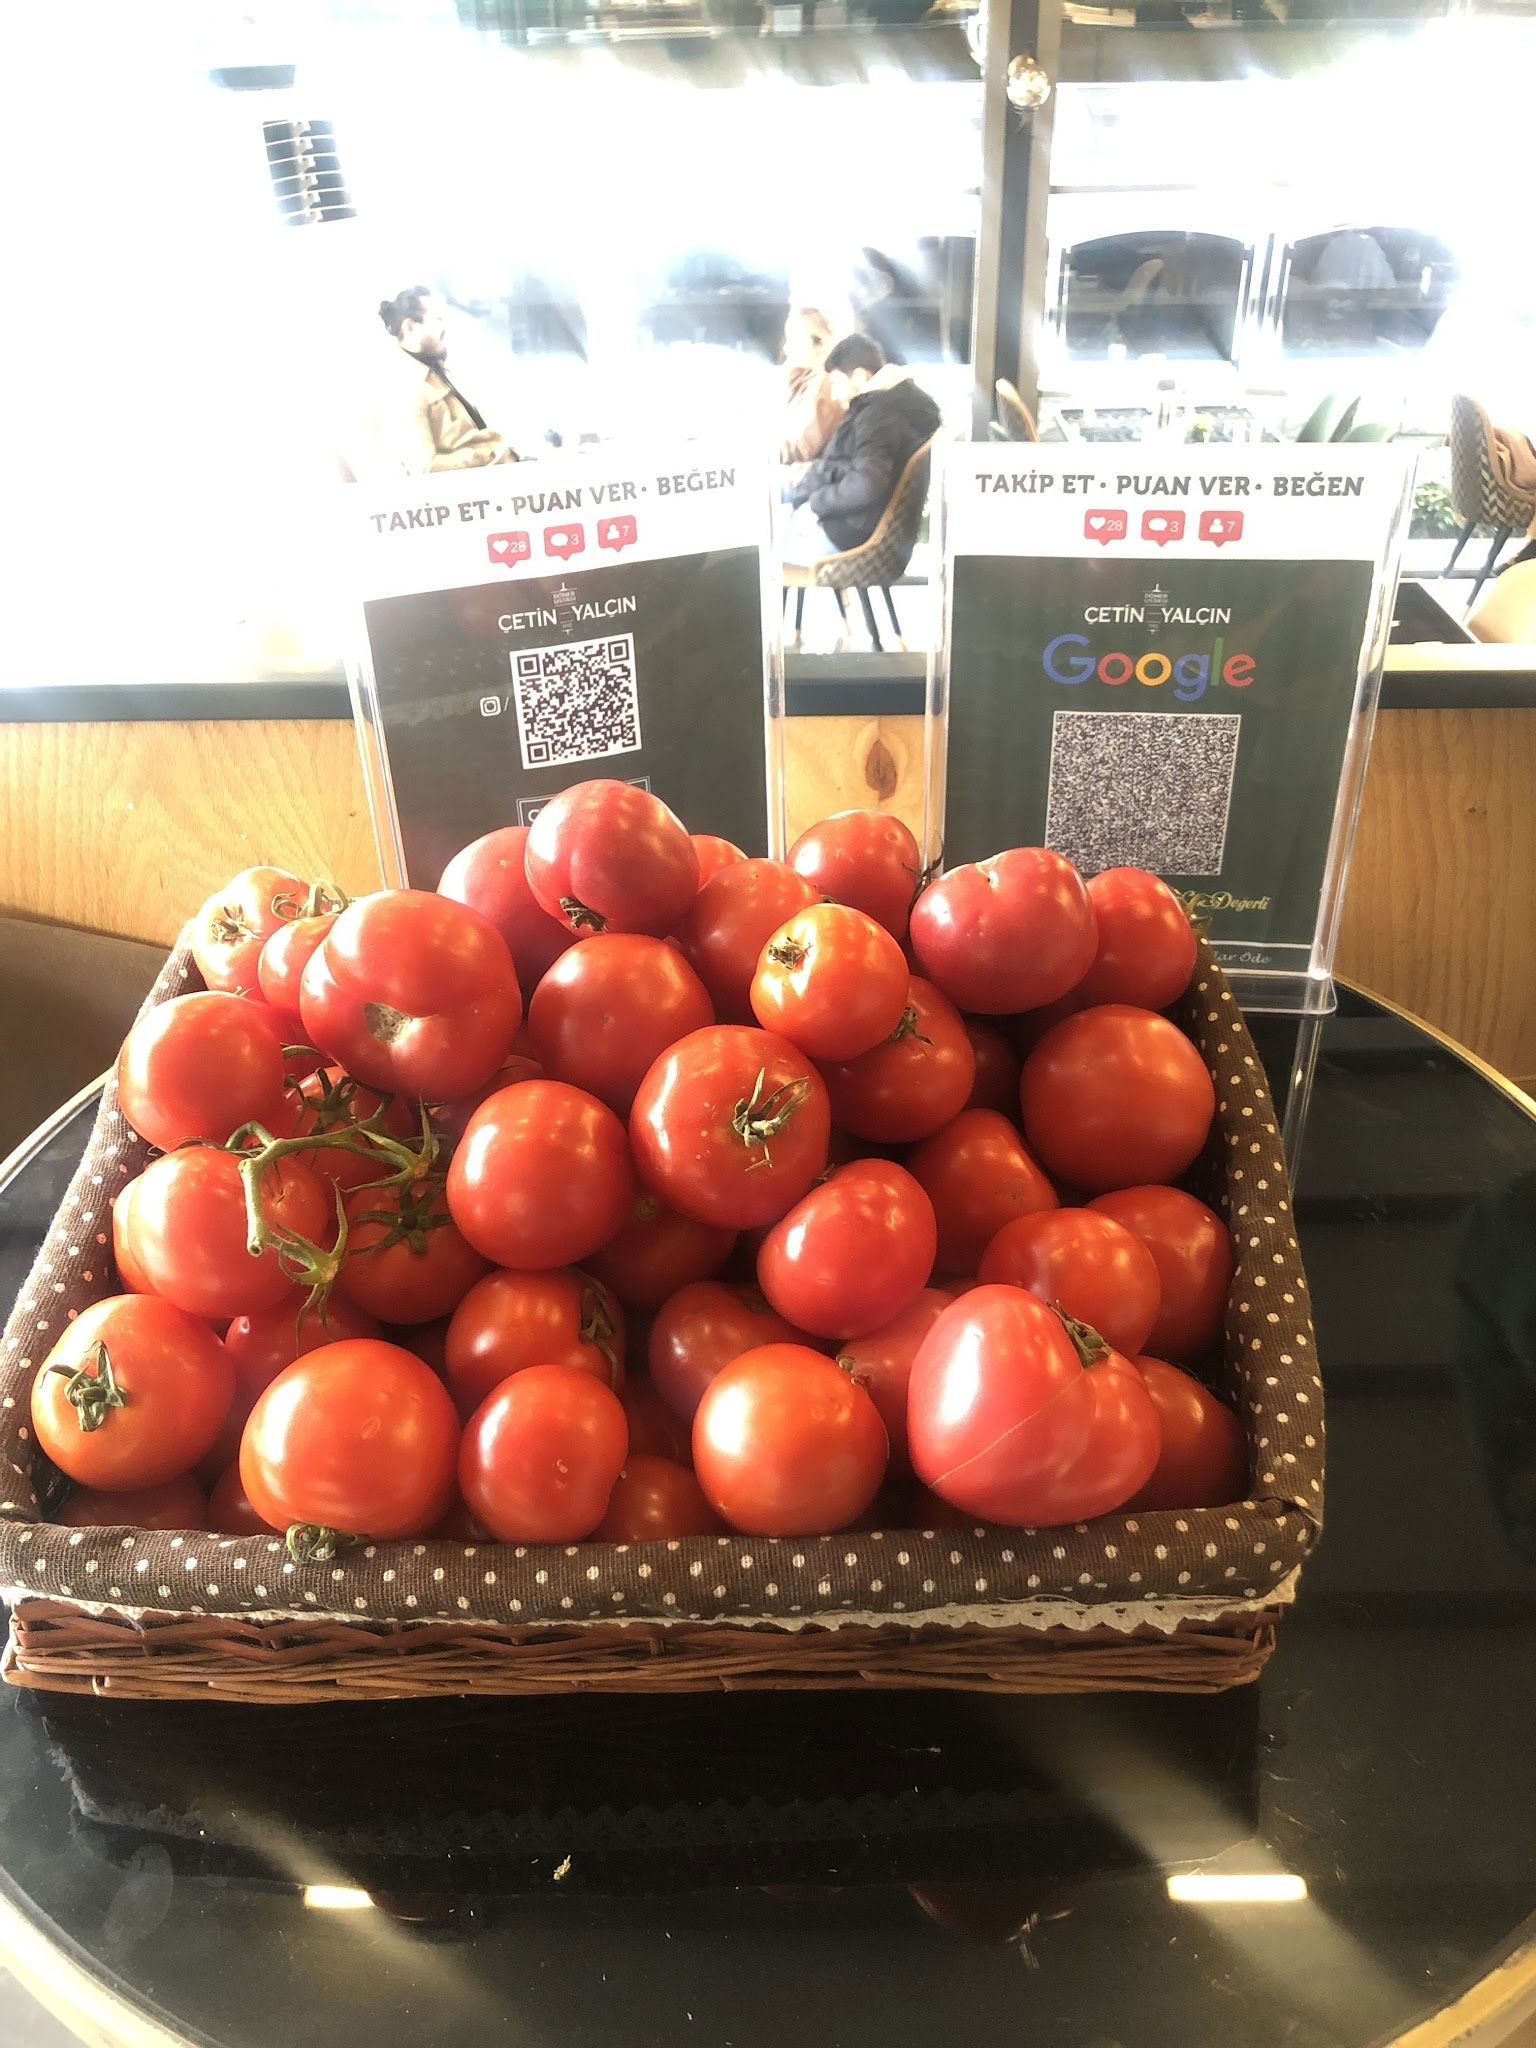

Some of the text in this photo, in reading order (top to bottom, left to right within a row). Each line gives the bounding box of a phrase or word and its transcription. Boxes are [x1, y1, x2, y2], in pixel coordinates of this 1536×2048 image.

[975, 469, 1055, 494] TAKİP
[1116, 475, 1191, 496] PUAN
[1273, 471, 1365, 497] BEĞEN
[370, 502, 451, 533] TAKİP
[511, 487, 582, 516] PUAN
[656, 468, 736, 496] BEĞEN
[621, 525, 630, 537] 7
[1106, 519, 1123, 532] 28
[1169, 521, 1180, 533] 3
[1226, 520, 1236, 533] 7
[570, 533, 579, 546] 3
[509, 540, 527, 553] 28
[497, 595, 637, 633] ÇETİN YALÇIN
[1084, 604, 1232, 626] ÇETİN YALÇIN
[1042, 633, 1257, 701] Google
